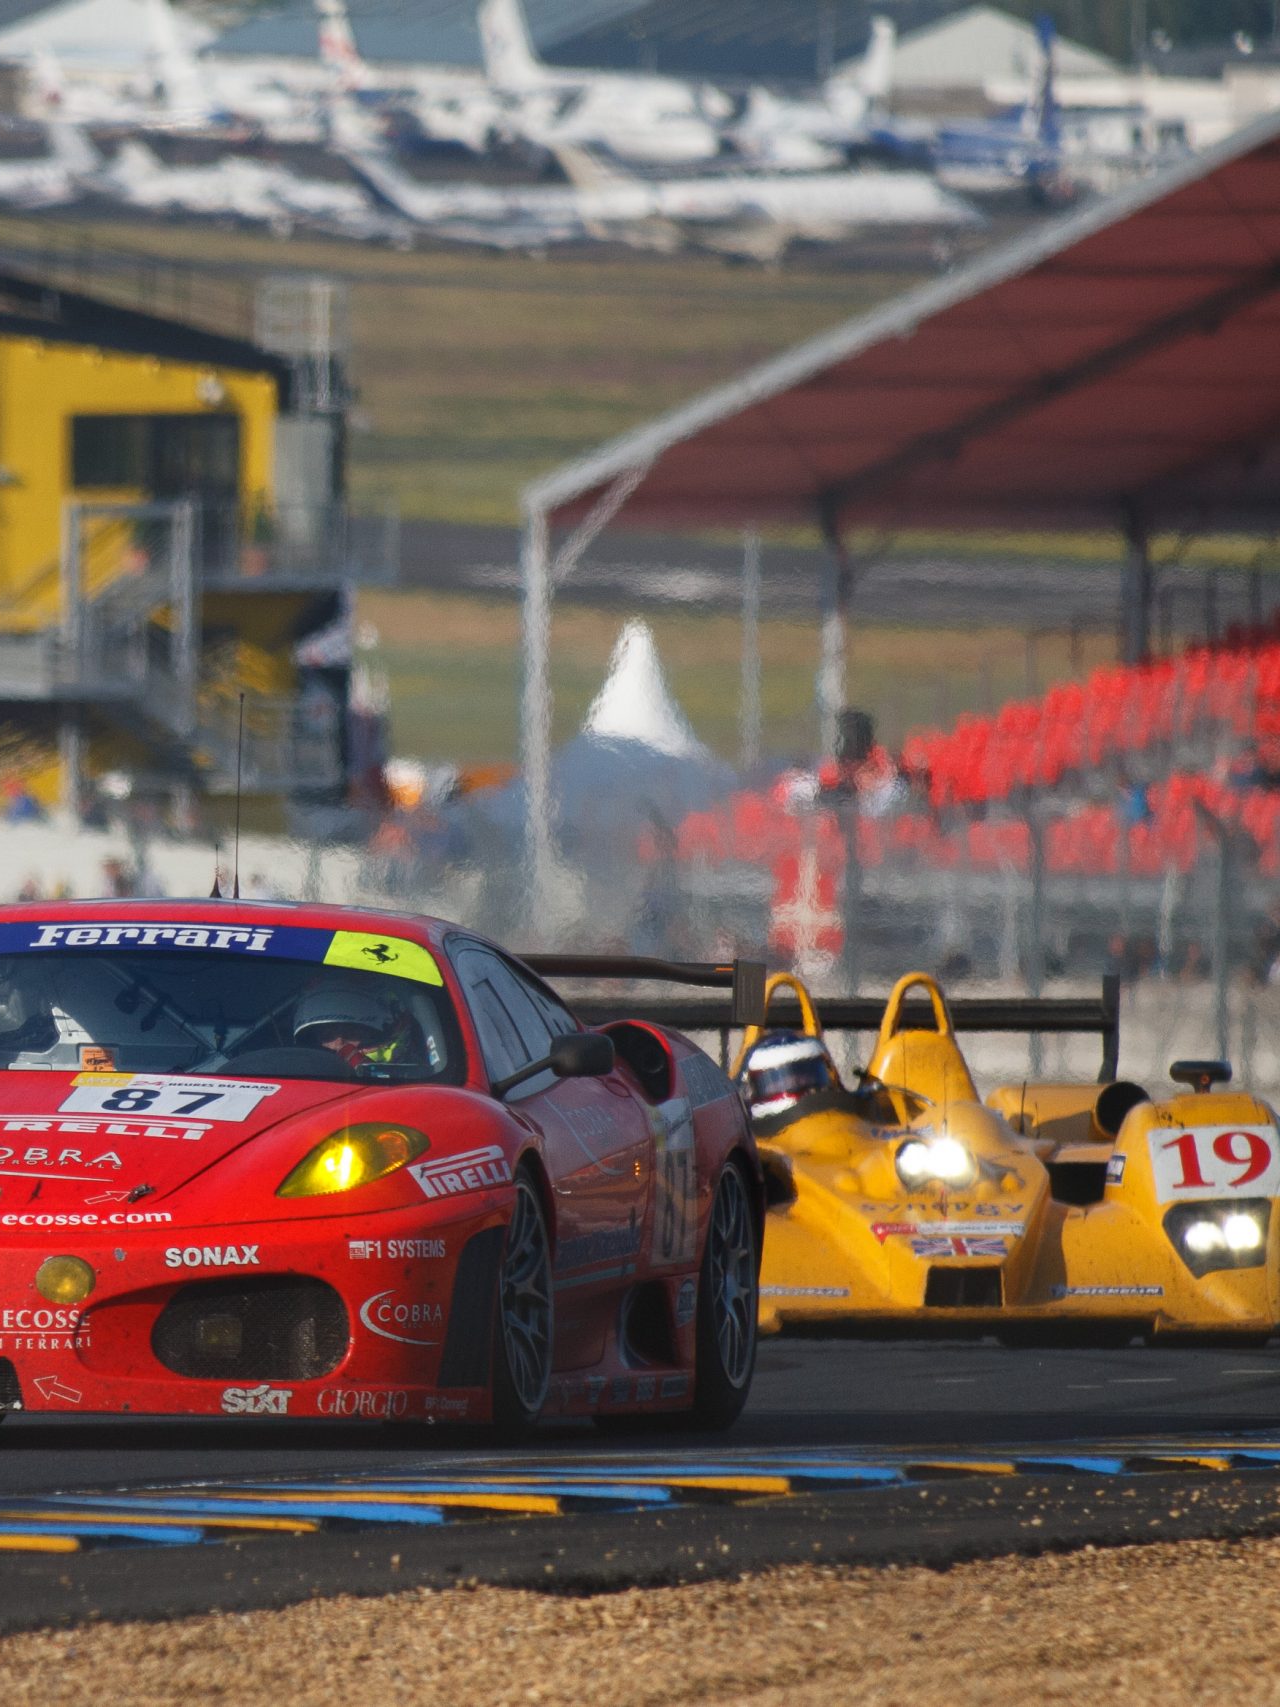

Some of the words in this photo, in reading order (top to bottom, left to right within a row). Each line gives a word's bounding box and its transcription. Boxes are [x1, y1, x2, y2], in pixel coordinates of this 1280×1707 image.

[29, 923, 274, 951] Ferrari
[101, 1088, 225, 1115] 87
[84, 1162, 122, 1170] PLC
[407, 1144, 512, 1198] PIRELLI
[1161, 1131, 1272, 1189] 19
[165, 1245, 260, 1267] SONAX
[365, 1241, 382, 1258] F1
[387, 1240, 446, 1258] SYSTEMS
[2, 1309, 91, 1329] ECOSSE
[378, 1304, 442, 1322] COBRA
[15, 1336, 91, 1350] FERRARI
[221, 1384, 293, 1414] SIXT
[317, 1389, 407, 1415] GIORGIO
